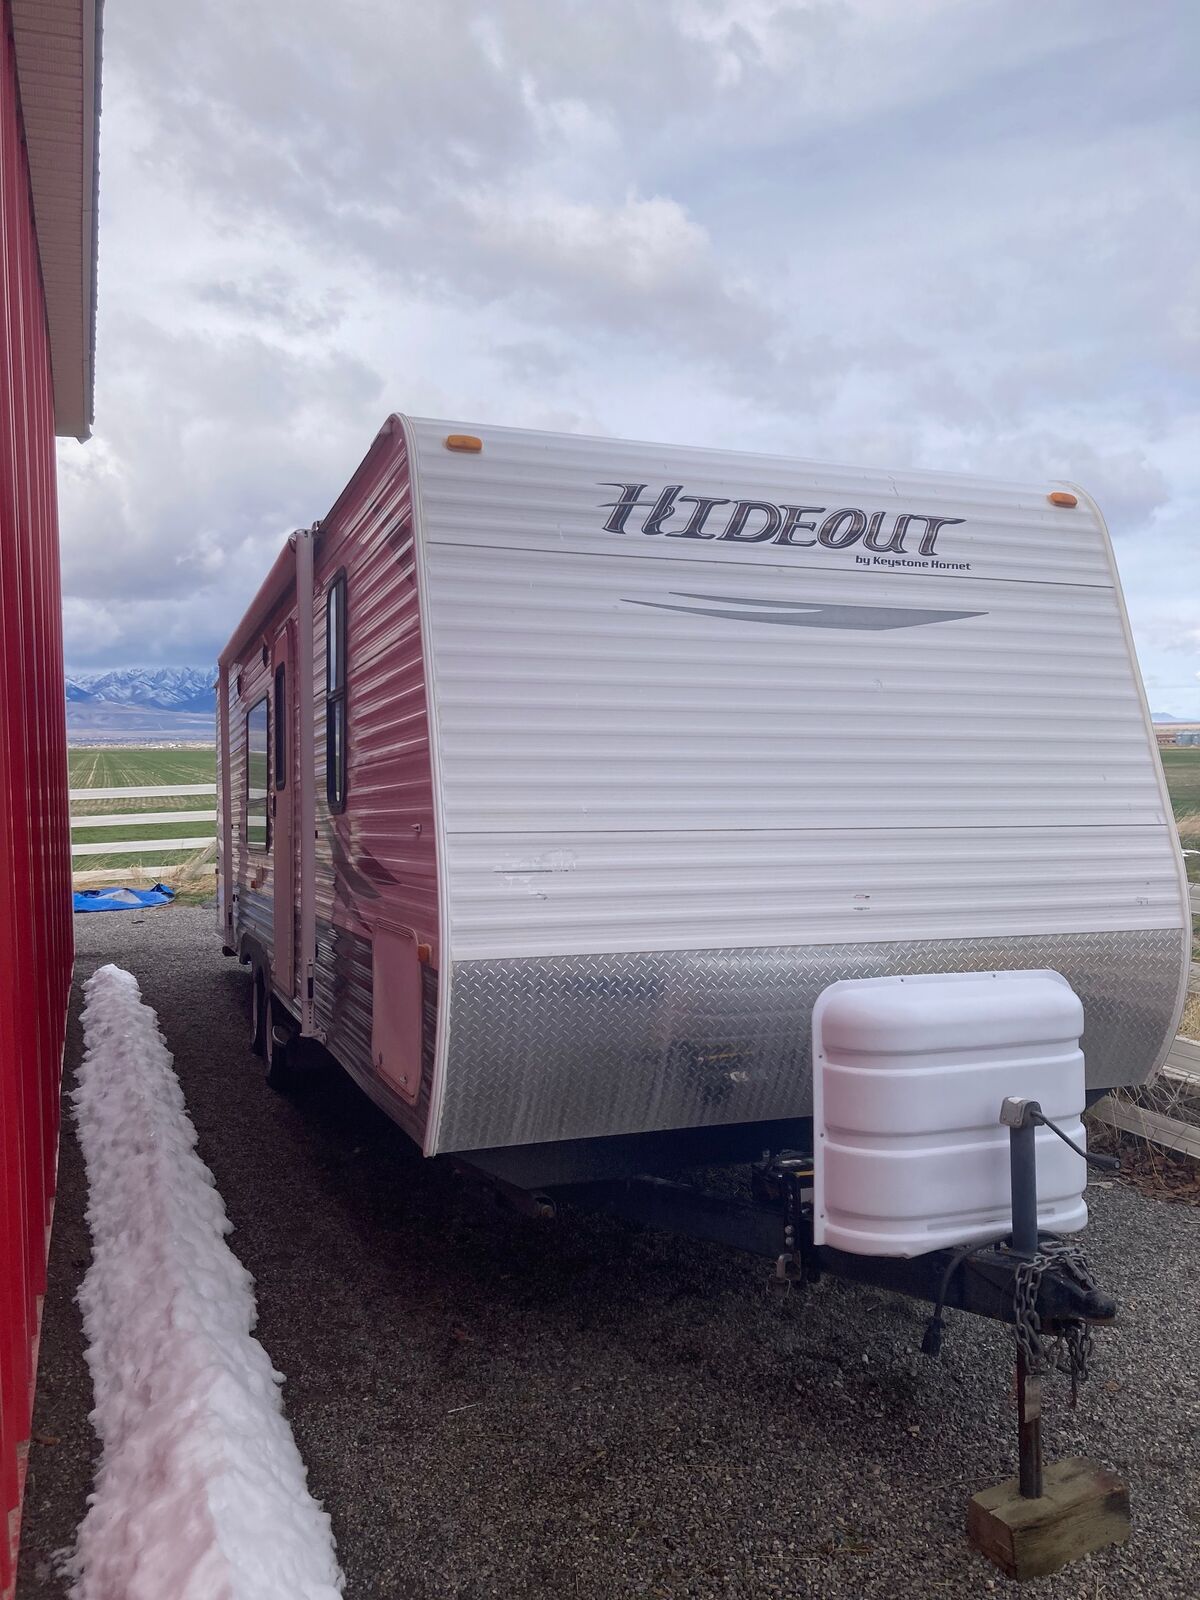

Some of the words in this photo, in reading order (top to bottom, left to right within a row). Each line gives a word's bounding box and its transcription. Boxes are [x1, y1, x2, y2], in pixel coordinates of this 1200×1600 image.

[597, 482, 966, 556] HIDEOUT
[855, 555, 870, 566] by
[873, 556, 929, 568] Keystone
[931, 560, 972, 570] Hornet
